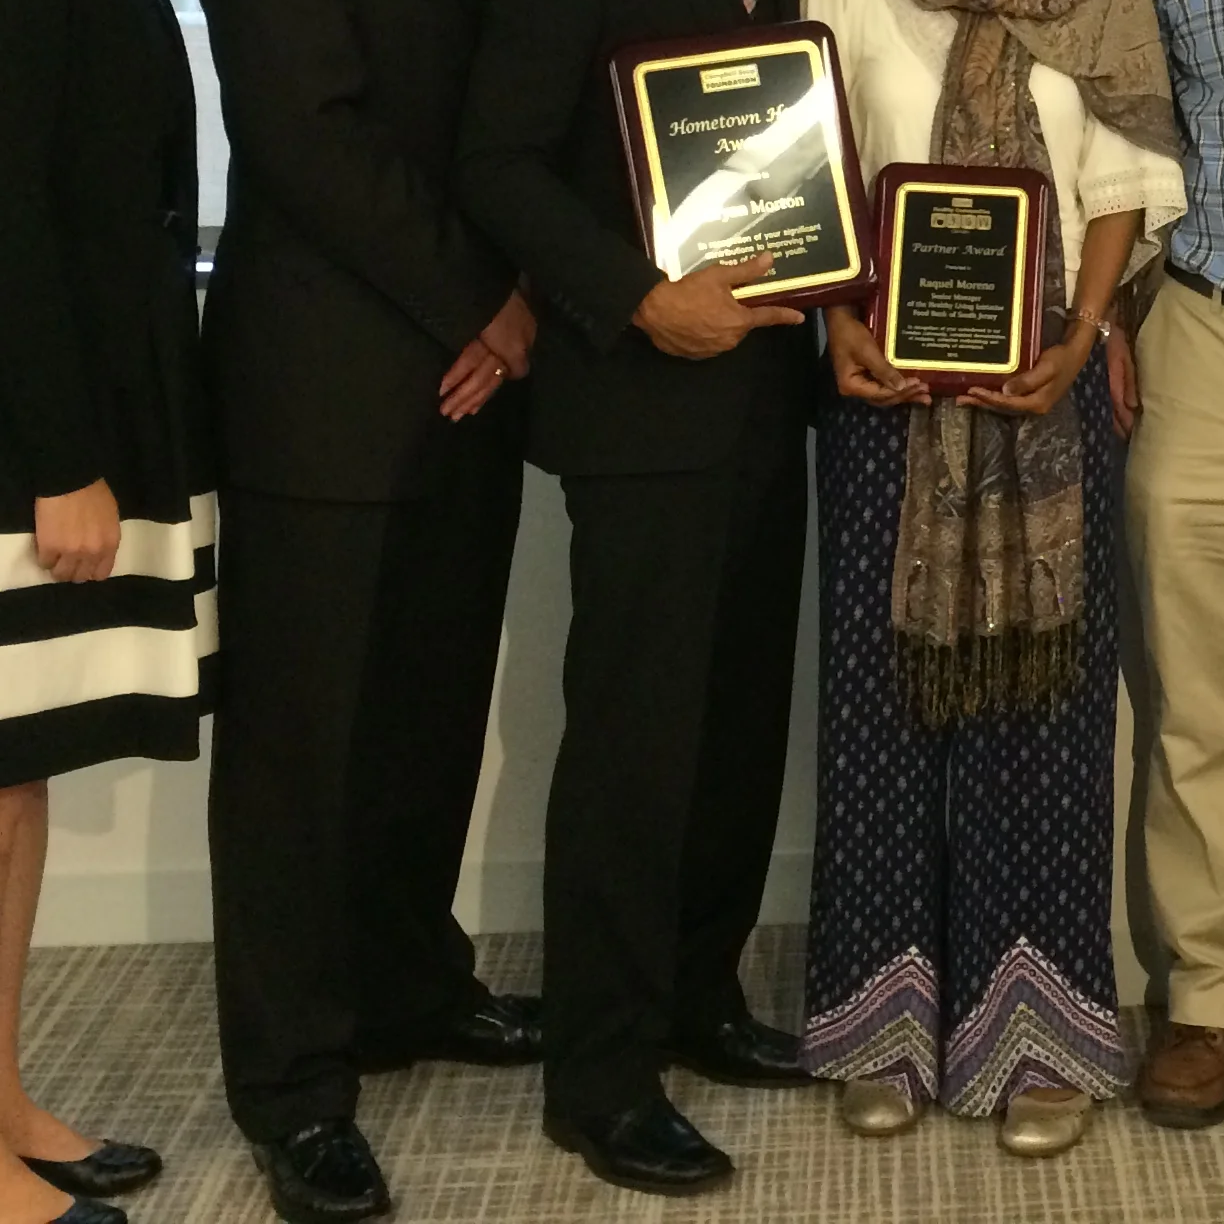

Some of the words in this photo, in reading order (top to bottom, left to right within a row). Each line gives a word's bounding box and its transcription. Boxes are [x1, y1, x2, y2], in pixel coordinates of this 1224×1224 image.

[706, 77, 757, 89] FOUNDATION
[669, 112, 761, 137] Hometown
[750, 195, 805, 214] Morton
[753, 232, 762, 242] of
[764, 230, 781, 241] your
[756, 243, 765, 251] to
[767, 237, 804, 249] improving
[806, 234, 819, 243] the
[912, 242, 959, 255] Partner
[962, 244, 1007, 256] Award
[919, 277, 953, 290] Raquel
[957, 280, 995, 291] Moreno
